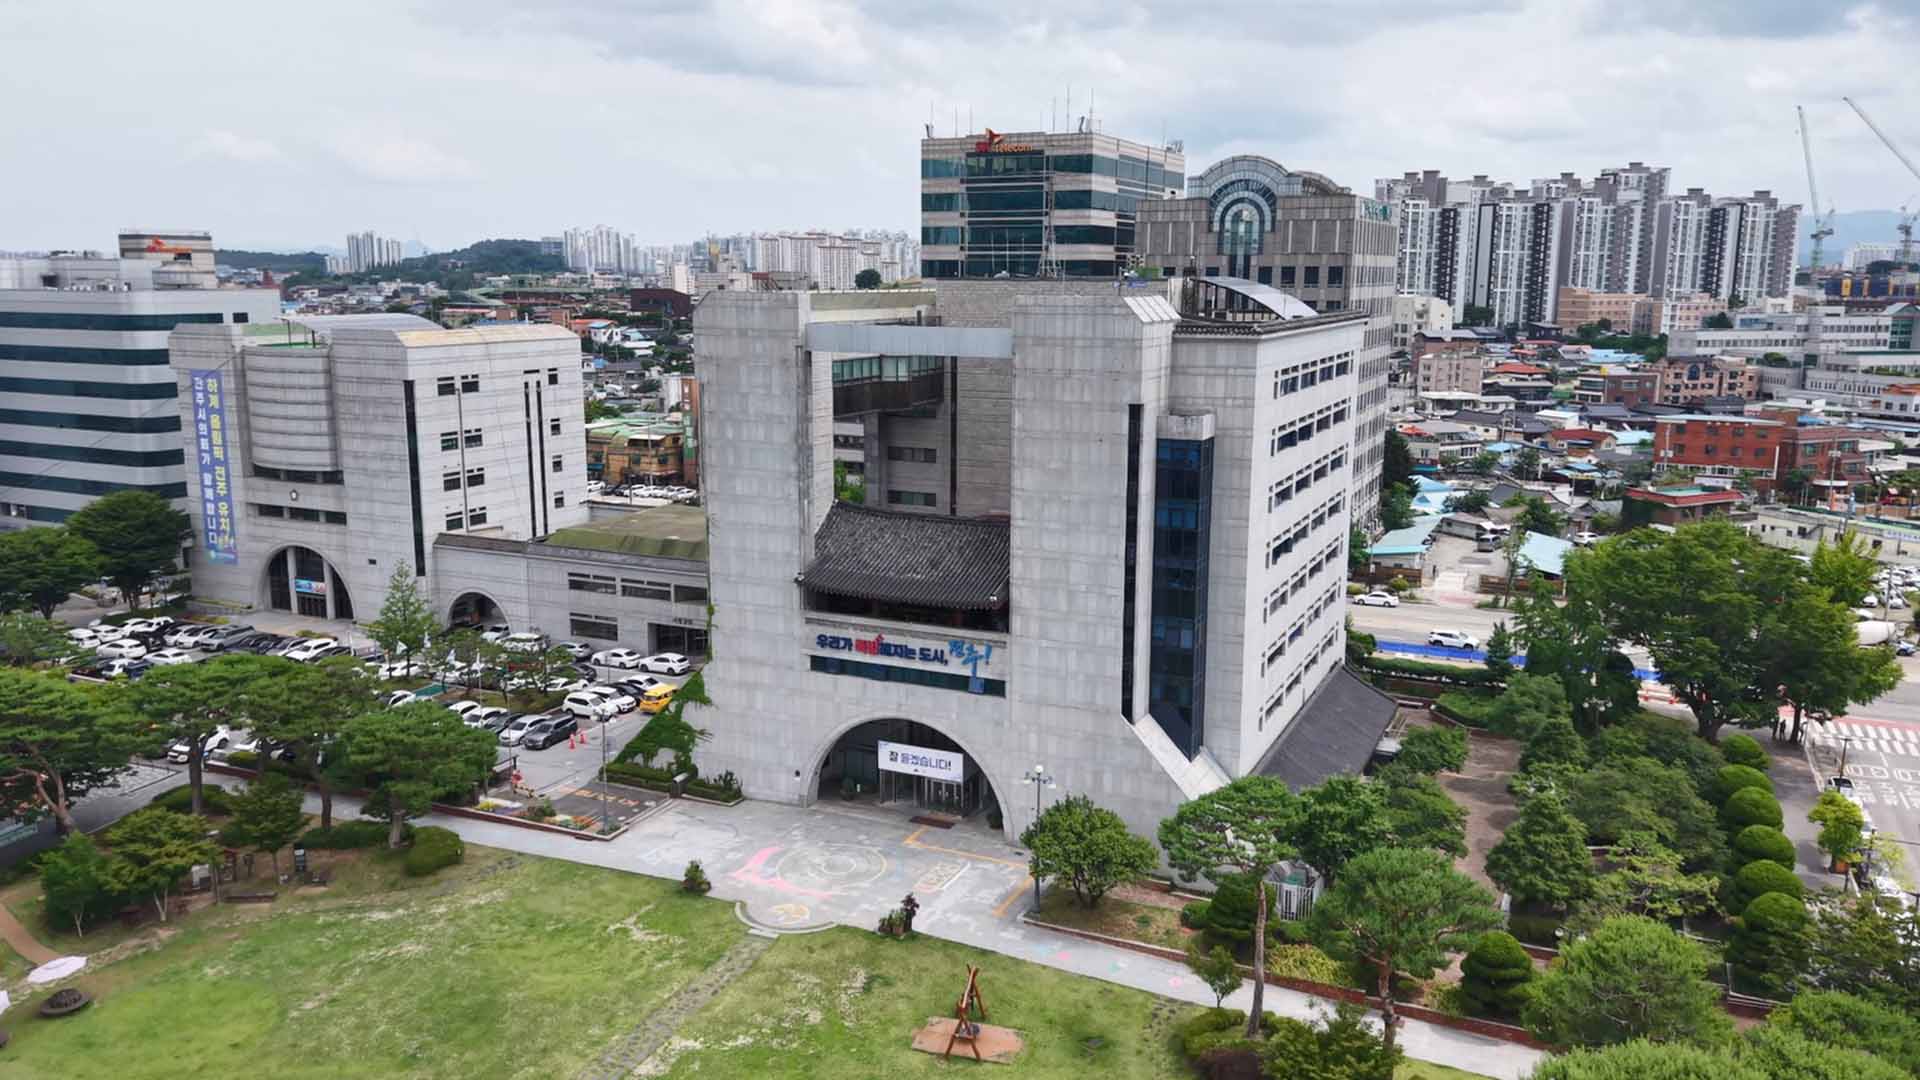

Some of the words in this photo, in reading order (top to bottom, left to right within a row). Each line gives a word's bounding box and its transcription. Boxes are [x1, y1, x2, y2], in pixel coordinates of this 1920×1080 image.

[194, 376, 211, 465] 전주시의회가
[203, 472, 218, 545] 함께합니다
[214, 465, 228, 497] 전주
[218, 501, 231, 533] 유치
[816, 633, 853, 652] 우리가
[855, 633, 917, 661] 해지는
[918, 647, 949, 666] 도시,
[889, 750, 899, 762] 잘
